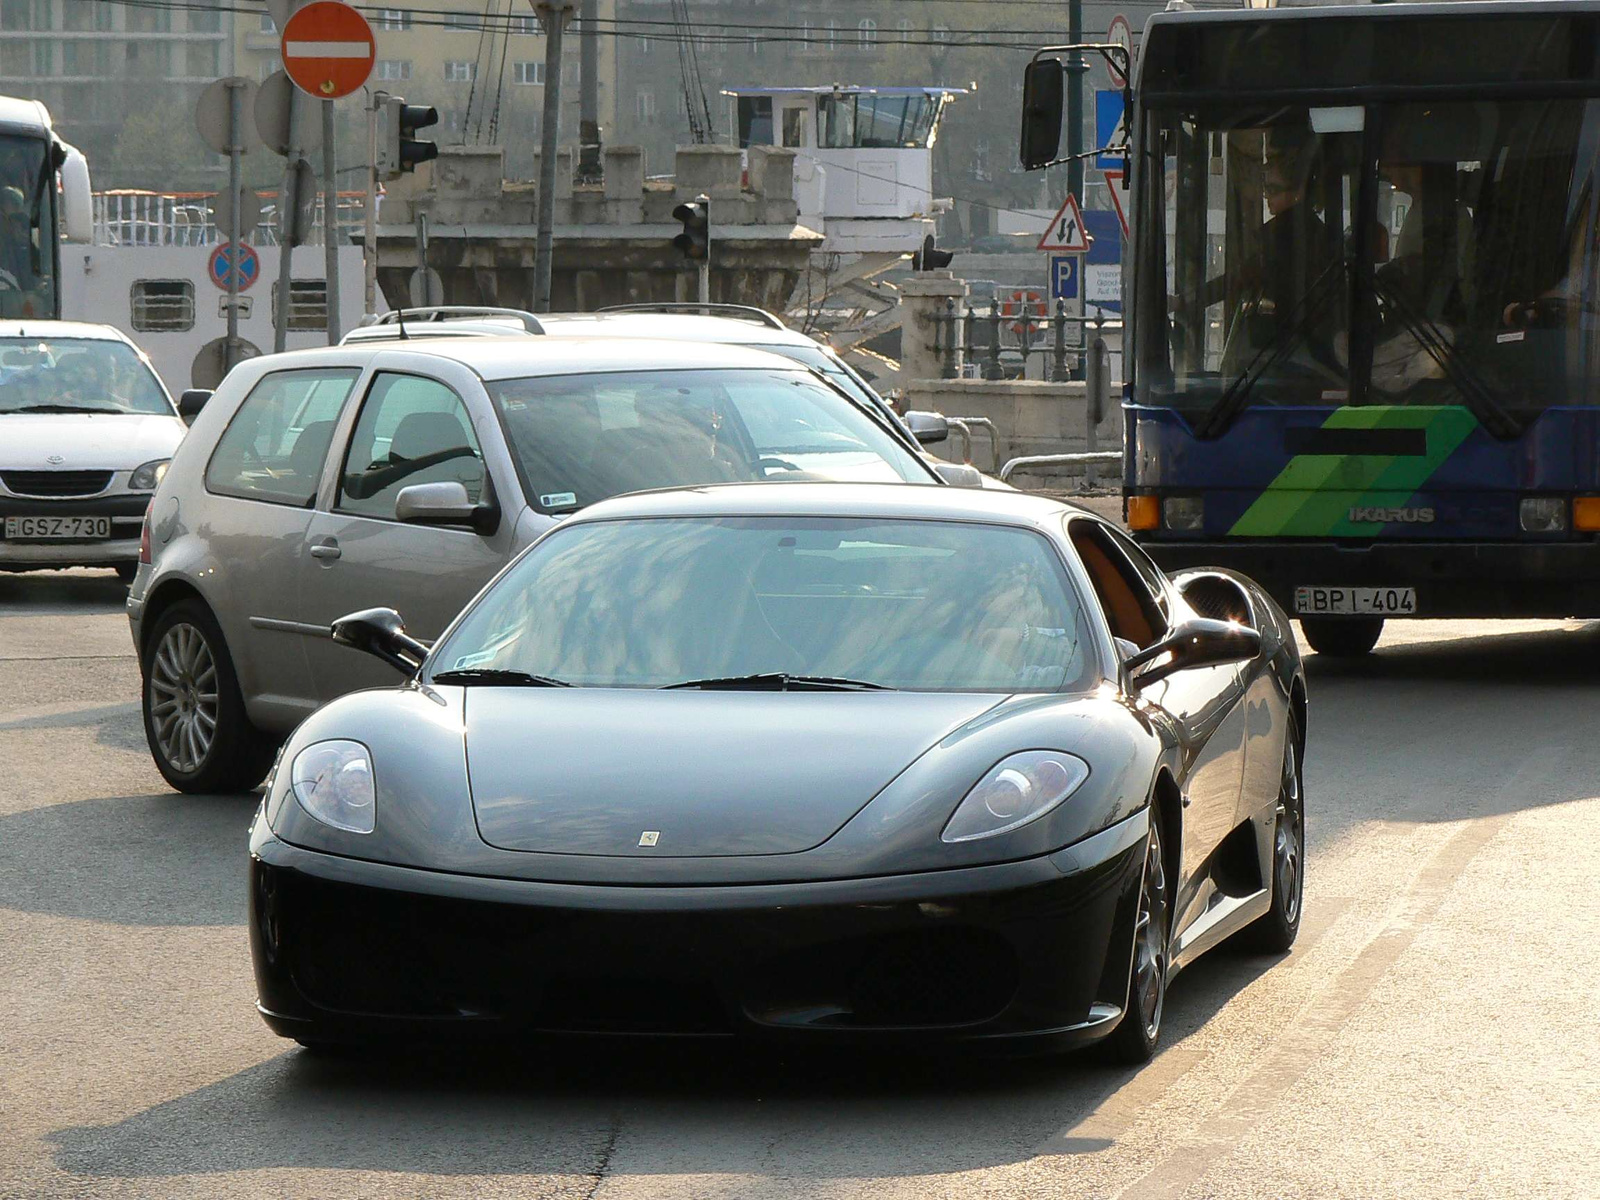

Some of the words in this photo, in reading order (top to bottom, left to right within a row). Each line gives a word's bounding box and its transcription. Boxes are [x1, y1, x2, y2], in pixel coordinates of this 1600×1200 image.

[1057, 261, 1072, 293] P
[1349, 507, 1435, 523] IKARUS
[22, 518, 108, 535] GSZ-730
[1313, 589, 1412, 612] BPI-404
